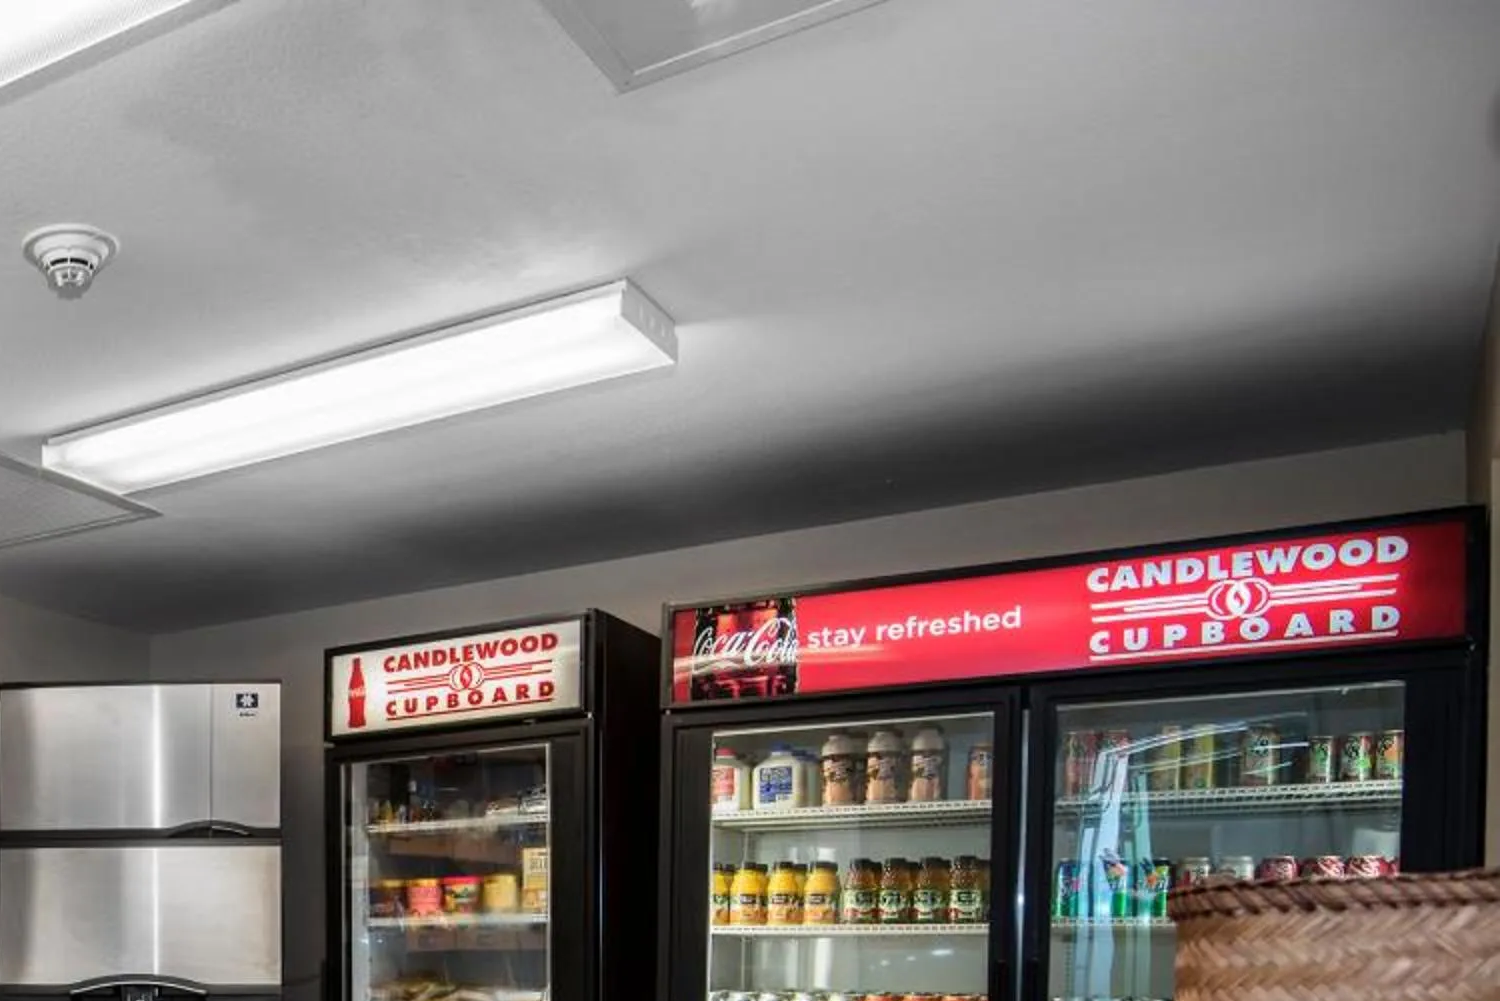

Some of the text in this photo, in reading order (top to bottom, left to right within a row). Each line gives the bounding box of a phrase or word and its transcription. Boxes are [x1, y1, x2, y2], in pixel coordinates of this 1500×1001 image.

[1087, 536, 1409, 592] CANDLEWOOD
[693, 617, 799, 666] Coca-Cola
[807, 605, 1022, 649] stay refreshed
[1089, 606, 1401, 655] CUPBOARD
[384, 633, 559, 673] CANDLEWOOD
[386, 681, 555, 716] CUPBOARD
